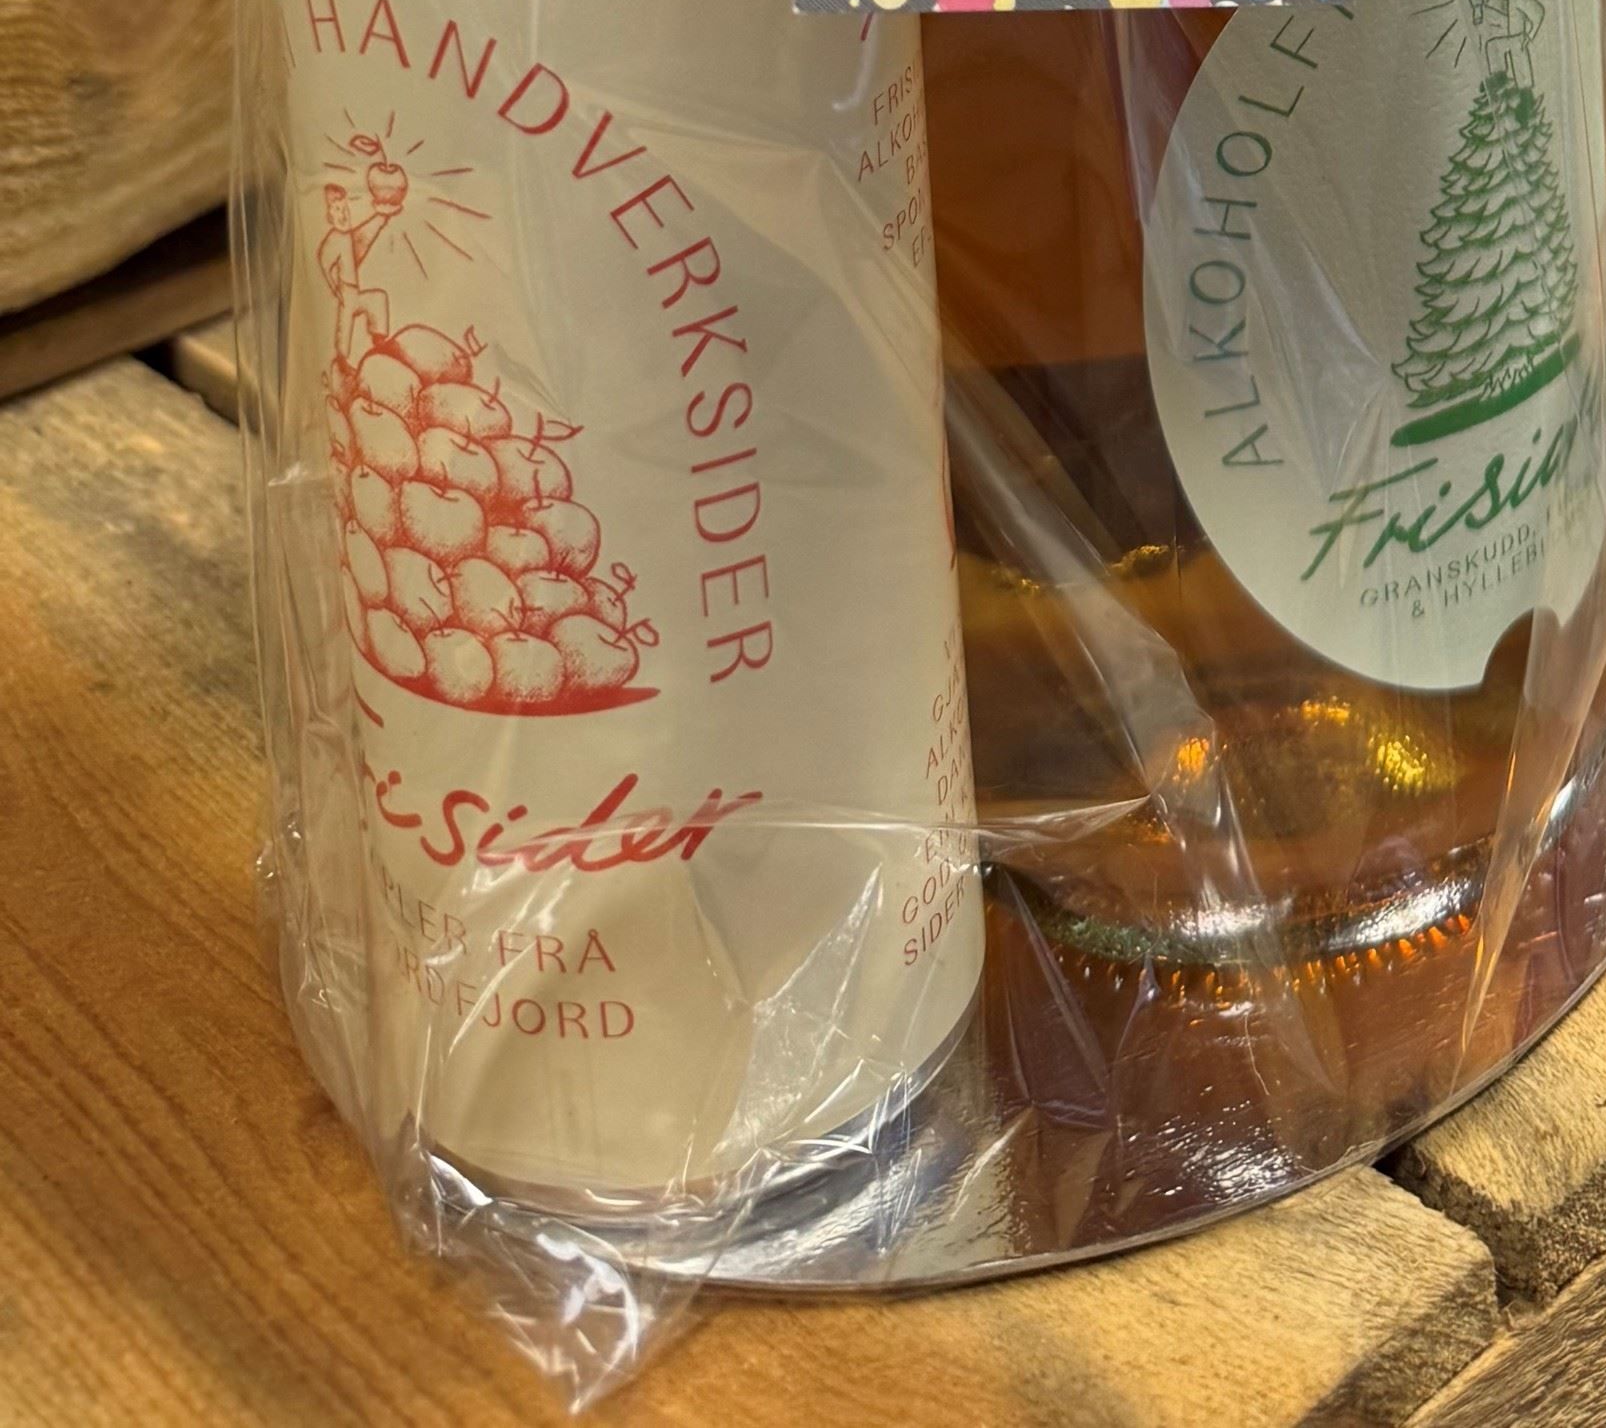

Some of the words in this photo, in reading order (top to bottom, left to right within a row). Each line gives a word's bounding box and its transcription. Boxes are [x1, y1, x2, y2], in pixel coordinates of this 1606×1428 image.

[1411, 599, 1425, 619] &
[496, 928, 616, 975] FRÅ
[904, 875, 966, 967] SIDER
[392, 939, 636, 1039] RDFJORD
